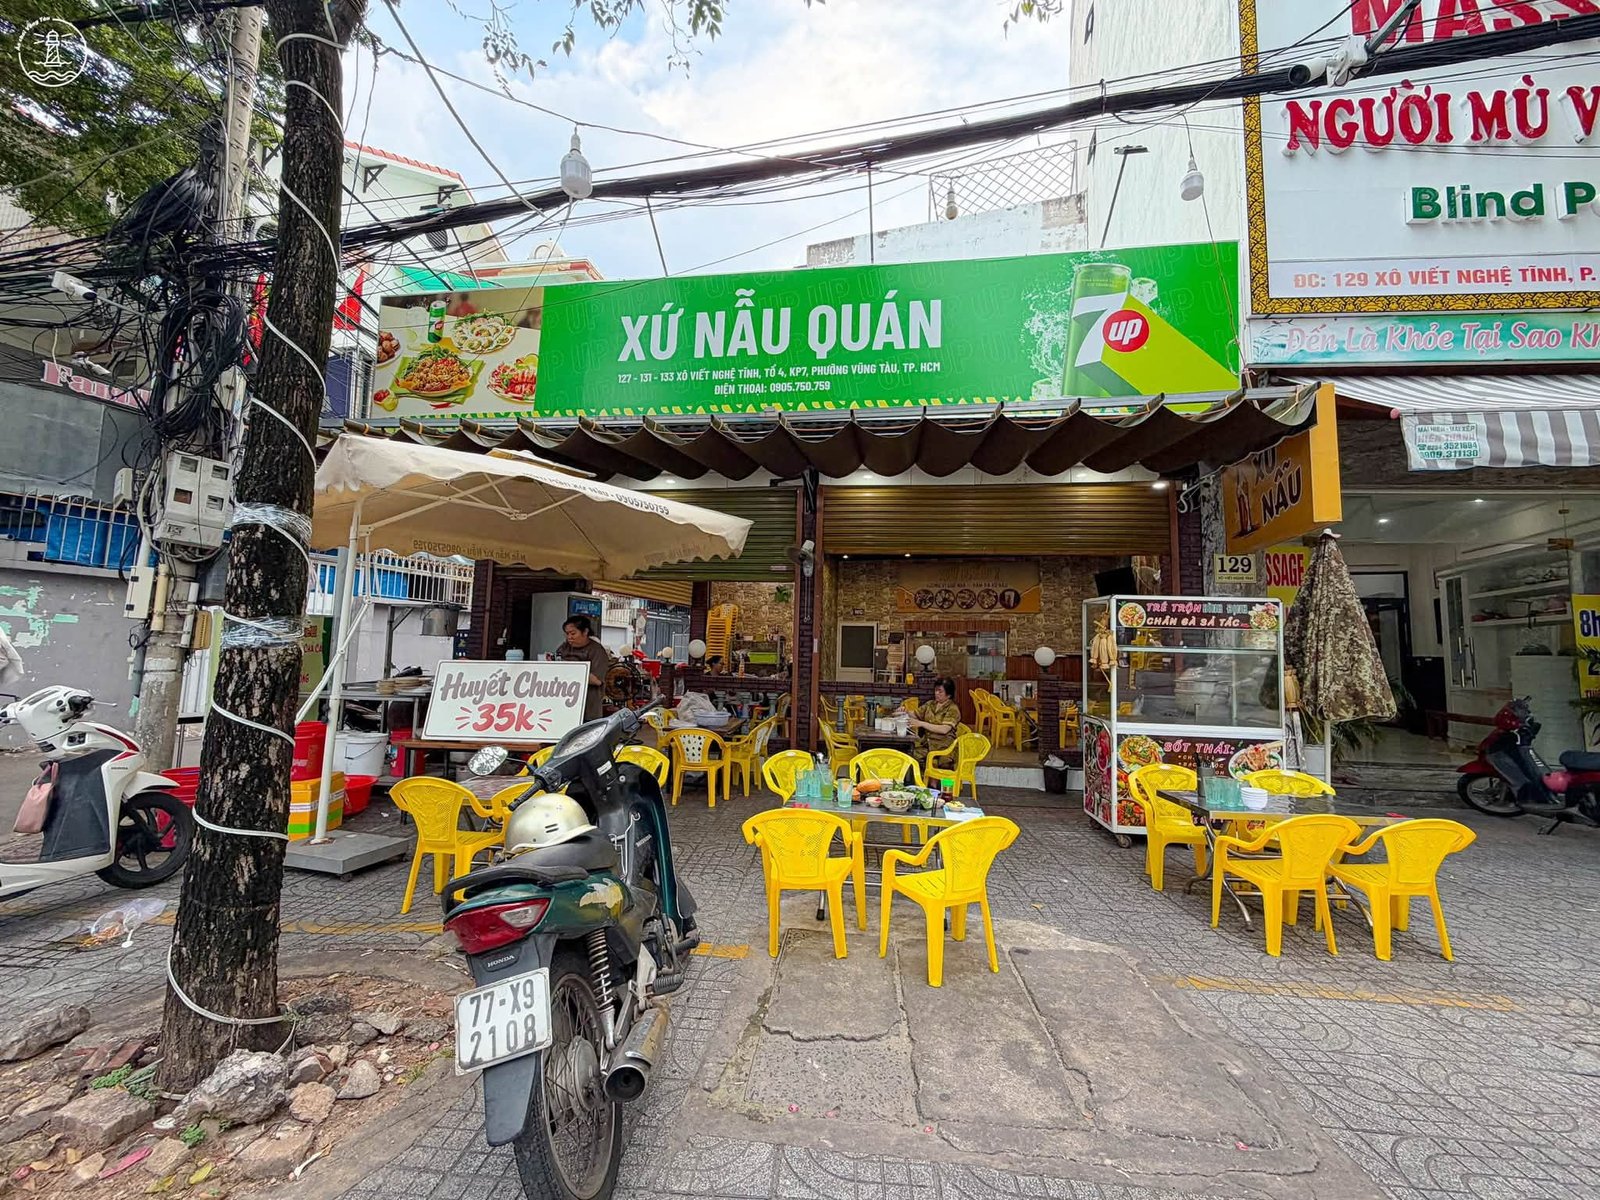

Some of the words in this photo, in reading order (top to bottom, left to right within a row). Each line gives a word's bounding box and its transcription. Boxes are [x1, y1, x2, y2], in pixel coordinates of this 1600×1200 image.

[1286, 79, 1454, 150] NGƯỜI
[1467, 75, 1550, 142] MÙ
[1411, 183, 1545, 219] Blind
[1564, 181, 1600, 215] P
[1293, 273, 1326, 288] ĐC:
[1333, 272, 1368, 288] 129
[1375, 268, 1401, 286] XÔ
[1408, 266, 1450, 284] VIẾT
[1457, 265, 1512, 286] NGHỆ
[1518, 265, 1573, 283] TĨNH,
[1580, 267, 1597, 281] P.
[617, 302, 685, 362] XỨ
[693, 288, 791, 358] NẪU
[808, 290, 942, 359] QUÁN
[1286, 324, 1337, 353] Đến
[1346, 327, 1378, 351] Là
[1386, 321, 1453, 352] Khỏe
[1462, 322, 1502, 356] Tại
[1509, 322, 1562, 350] Sao
[617, 374, 632, 384] 127
[640, 373, 652, 383] 131
[660, 372, 675, 382] 133
[676, 370, 688, 381] XÔ
[690, 368, 710, 381] VIẾT
[712, 367, 735, 382] NGHỆ
[778, 367, 787, 378] 4,
[789, 366, 809, 378] KP7,
[851, 362, 877, 375] VŨNG
[879, 361, 900, 375] TÀU,
[903, 362, 918, 373] TP.
[920, 362, 941, 372] HCM
[714, 383, 735, 397] ĐIỆN
[738, 383, 767, 396] THOẠI:
[769, 381, 831, 393] 0905.750.759
[1262, 458, 1302, 526] NẪU
[1218, 556, 1252, 573] 129
[1146, 615, 1177, 626] CHÂN
[1181, 616, 1197, 626] GÀ
[441, 669, 511, 705] Huyết
[513, 671, 581, 707] Chưng
[473, 702, 535, 732] 35k
[1164, 739, 1191, 753] SỐT
[1195, 741, 1236, 755] THÁI:
[487, 955, 515, 967] HONDA
[470, 979, 535, 1028] 77-X9
[470, 1014, 537, 1065] 2108
